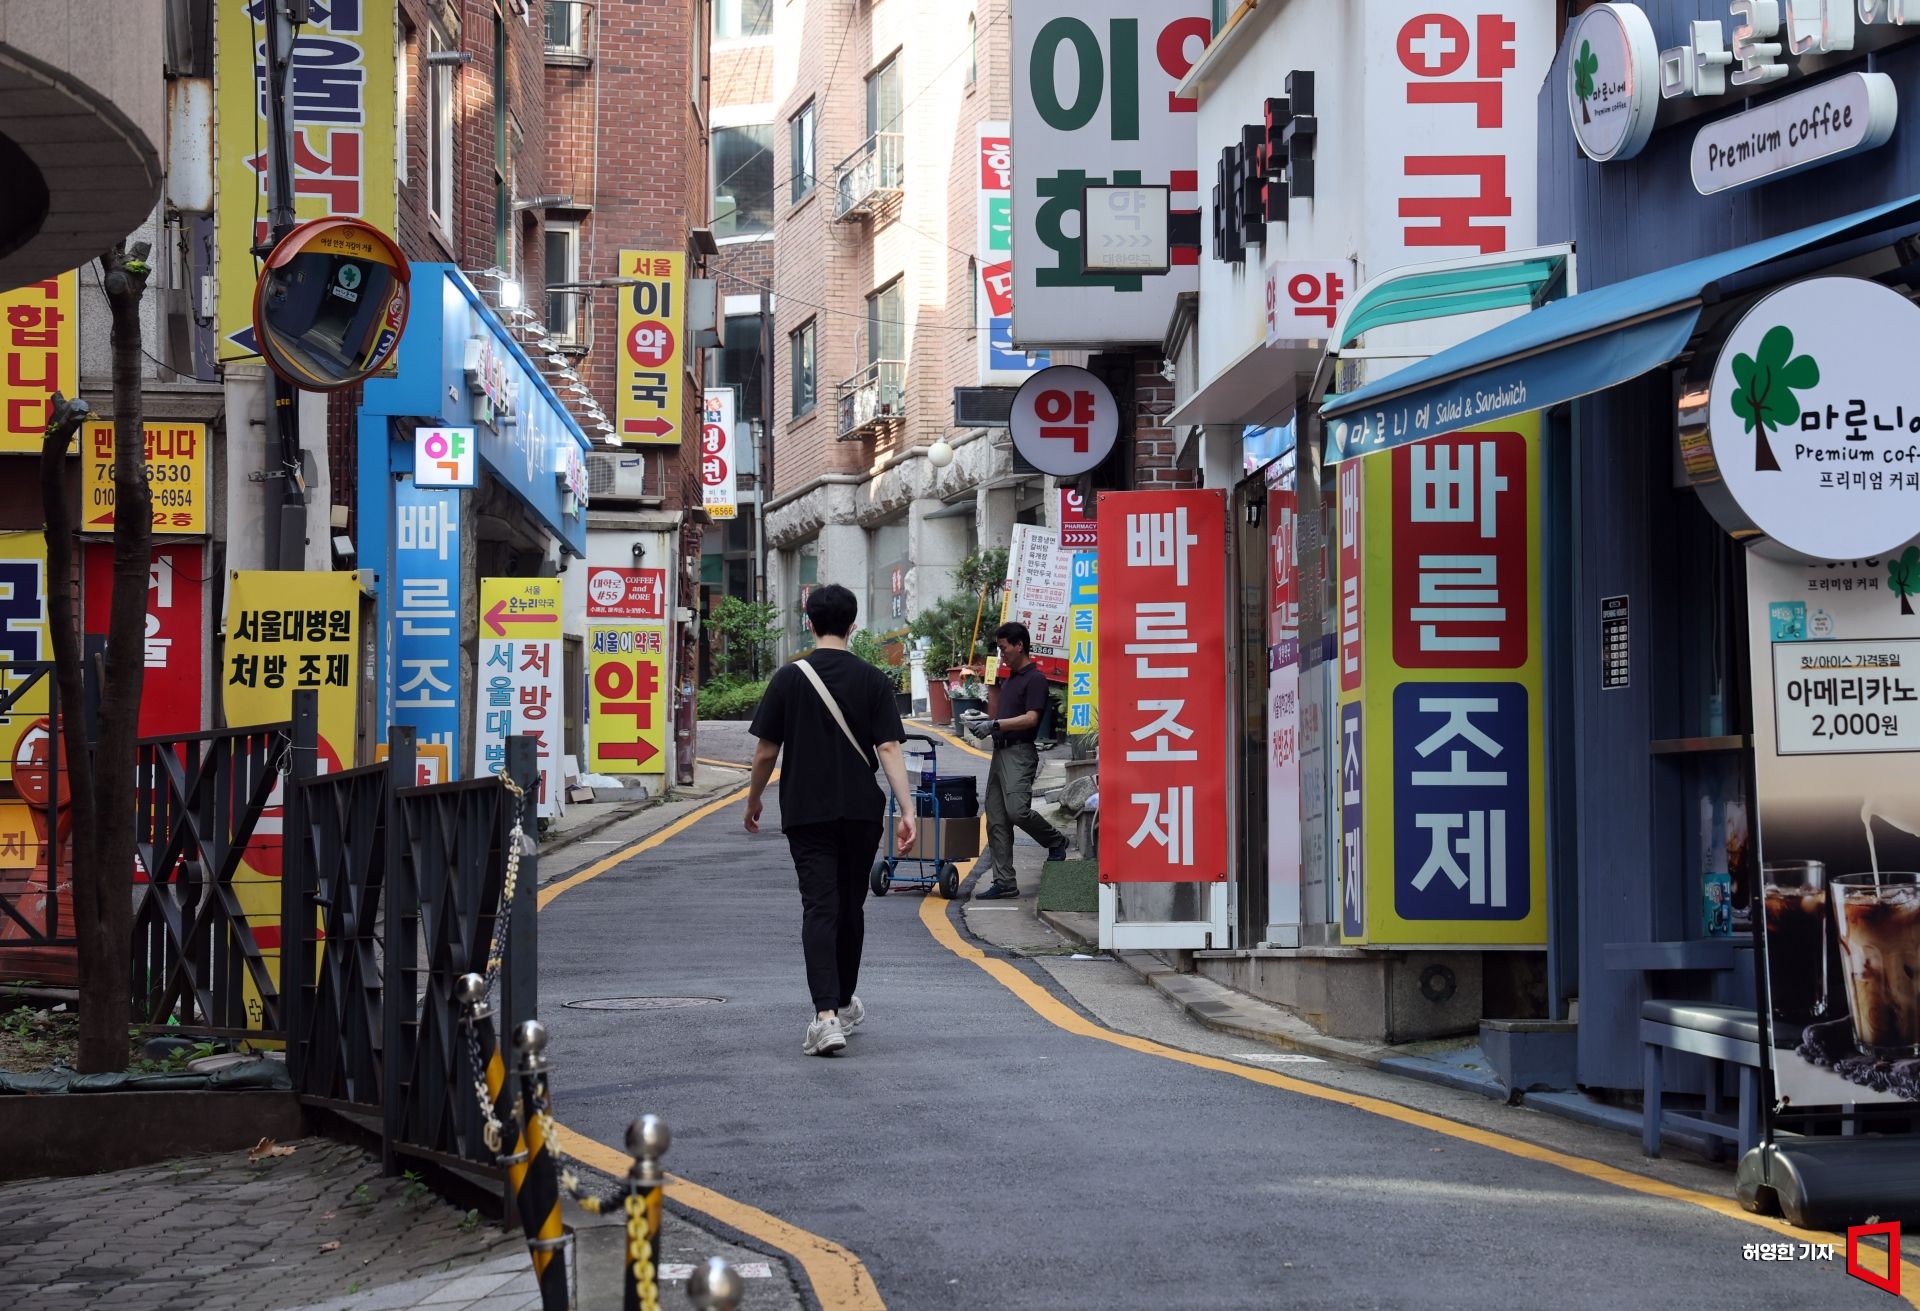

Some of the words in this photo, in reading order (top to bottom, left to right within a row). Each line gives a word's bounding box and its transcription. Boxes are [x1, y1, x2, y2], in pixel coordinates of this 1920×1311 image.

[1661, 0, 1915, 99] 마로니
[1593, 81, 1626, 101] 마로니에
[1396, 13, 1515, 254] 약국
[1709, 128, 1781, 171] Premium
[1789, 102, 1853, 147] coffee
[1109, 190, 1146, 231] 약
[334, 239, 345, 249] 안전
[632, 257, 672, 277] 서울
[1266, 276, 1276, 331] 약
[1288, 272, 1344, 328] 약
[7, 276, 64, 434] 합니다
[1435, 398, 1463, 427] Salad
[1464, 399, 1473, 418] &
[1475, 380, 1528, 414] Sandwich
[1034, 390, 1095, 453] 약
[94, 429, 196, 460] 민합니다
[424, 432, 465, 481] 약
[1795, 444, 1874, 463] Premium
[1883, 445, 1920, 463] cof
[95, 463, 191, 482] 766530
[1819, 471, 1883, 490] 프리미엄
[1889, 471, 1920, 491] 커피
[1031, 543, 1049, 553] 갈비탕
[1410, 441, 1508, 651] 빠른
[1028, 560, 1047, 569] 만두국
[1342, 463, 1360, 674] 빠른
[524, 585, 542, 595] 서울
[593, 578, 622, 589] 대학로
[625, 576, 655, 584] COFFEE
[597, 591, 618, 600] #55
[628, 593, 651, 601] MORE
[1808, 578, 1853, 591] 프리미엄
[1856, 577, 1880, 590] 커피
[510, 596, 555, 614] 온누리약국
[233, 610, 351, 643] 서울대병원
[592, 631, 662, 654] 서울이약국
[229, 654, 287, 689] 처방
[298, 654, 350, 688] 조제
[1801, 656, 1853, 669] 핫/아이스
[1856, 654, 1901, 668] 가격동일
[594, 661, 659, 730] 약
[1787, 676, 1918, 707] 아메리카노
[1812, 713, 1899, 740] 2,000원
[1410, 697, 1508, 908] 조제
[1343, 717, 1361, 924] 조제
